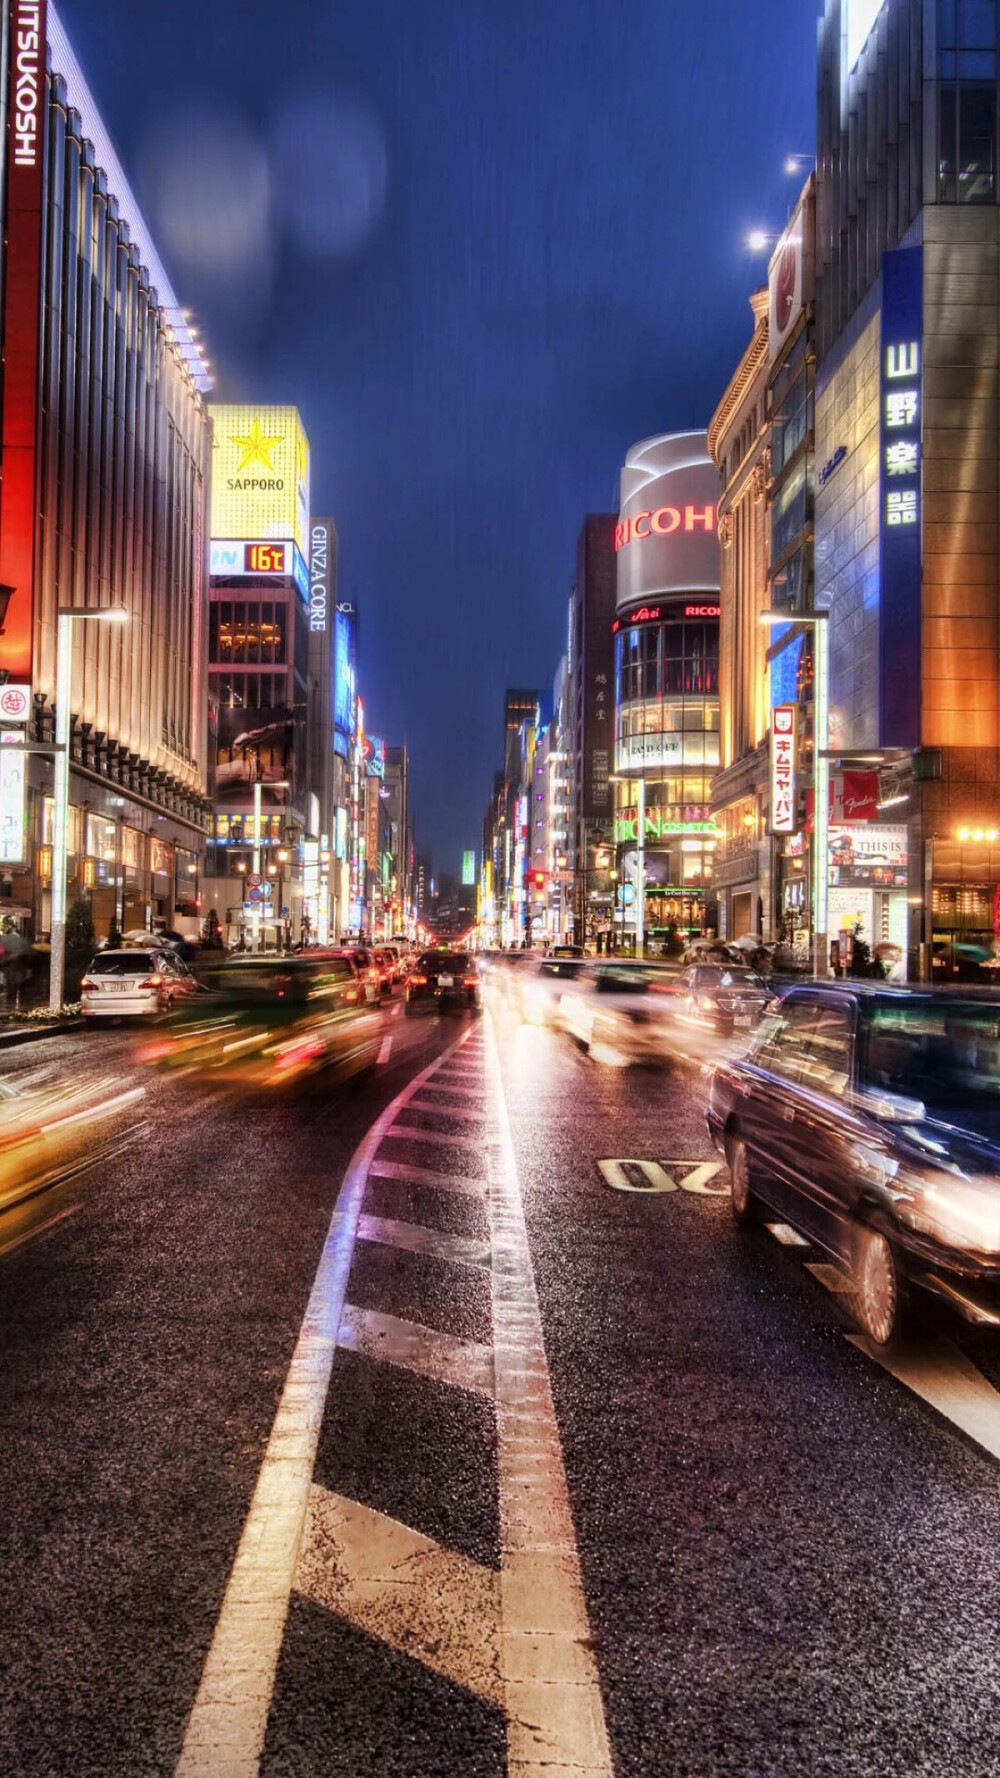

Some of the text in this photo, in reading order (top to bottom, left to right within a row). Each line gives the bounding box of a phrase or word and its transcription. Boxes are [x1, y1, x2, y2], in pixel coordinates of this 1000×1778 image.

[14, 0, 40, 166] ITSUKOSHI
[226, 478, 284, 491] SAPPORO
[614, 505, 714, 553] RICOH
[310, 526, 328, 632] GINZA CORE
[775, 740, 792, 825] キムラヤのパン
[858, 841, 902, 851] THIS IS
